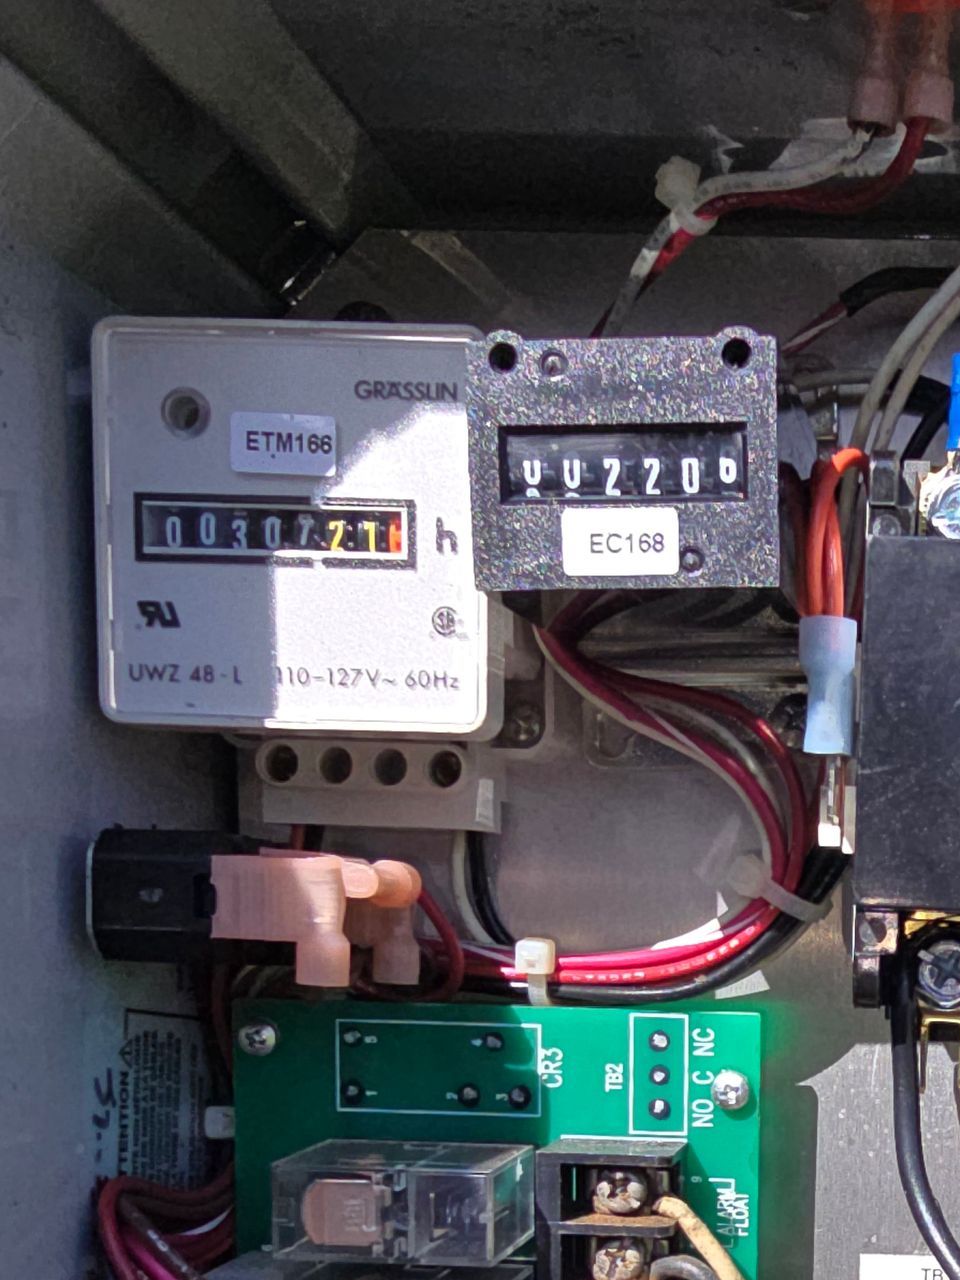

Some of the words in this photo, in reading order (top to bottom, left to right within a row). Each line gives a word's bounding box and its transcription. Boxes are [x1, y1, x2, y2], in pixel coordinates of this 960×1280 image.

[246, 430, 333, 455] ETM166
[436, 517, 458, 555] h
[590, 533, 665, 554] EC168
[128, 663, 180, 684] UWZ
[189, 664, 215, 684] 48
[232, 666, 243, 685] L
[405, 668, 460, 690] 60Hz
[691, 1027, 716, 1057] NC
[541, 1047, 564, 1089] CR3
[605, 1062, 624, 1093] TB2
[691, 1070, 715, 1085] C
[119, 1070, 130, 1177] TTENTION
[691, 1098, 715, 1127] NO
